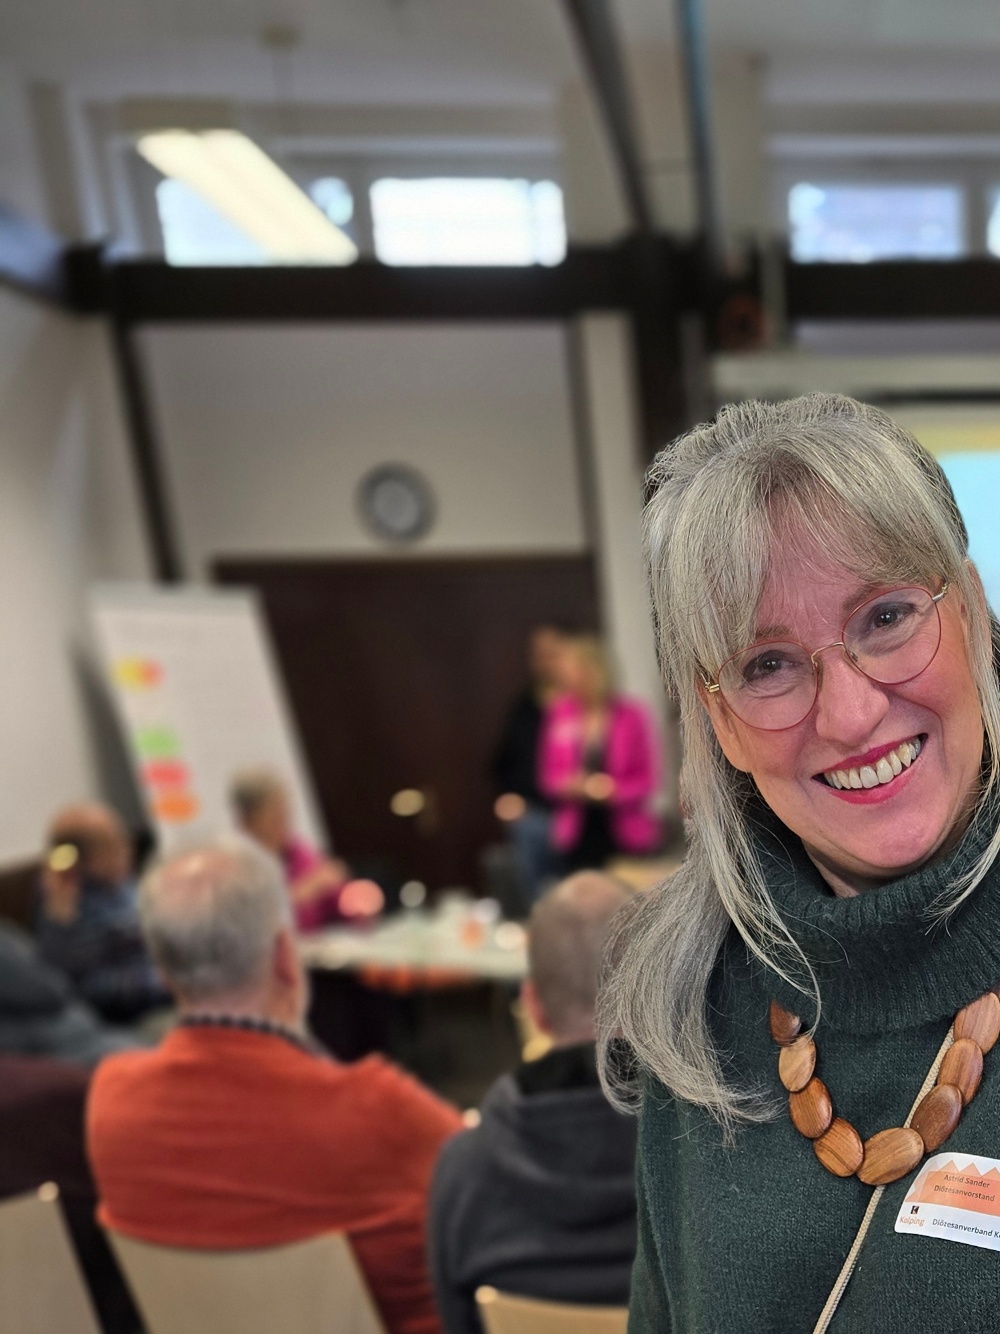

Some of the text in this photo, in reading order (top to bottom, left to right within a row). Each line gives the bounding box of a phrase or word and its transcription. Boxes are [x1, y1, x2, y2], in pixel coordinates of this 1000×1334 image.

[944, 1174, 990, 1188] Astrid Sander
[934, 1185, 995, 1202] Diözesanvorstand
[899, 1216, 925, 1227] Kolping
[932, 1218, 993, 1237] Diözesanverband
